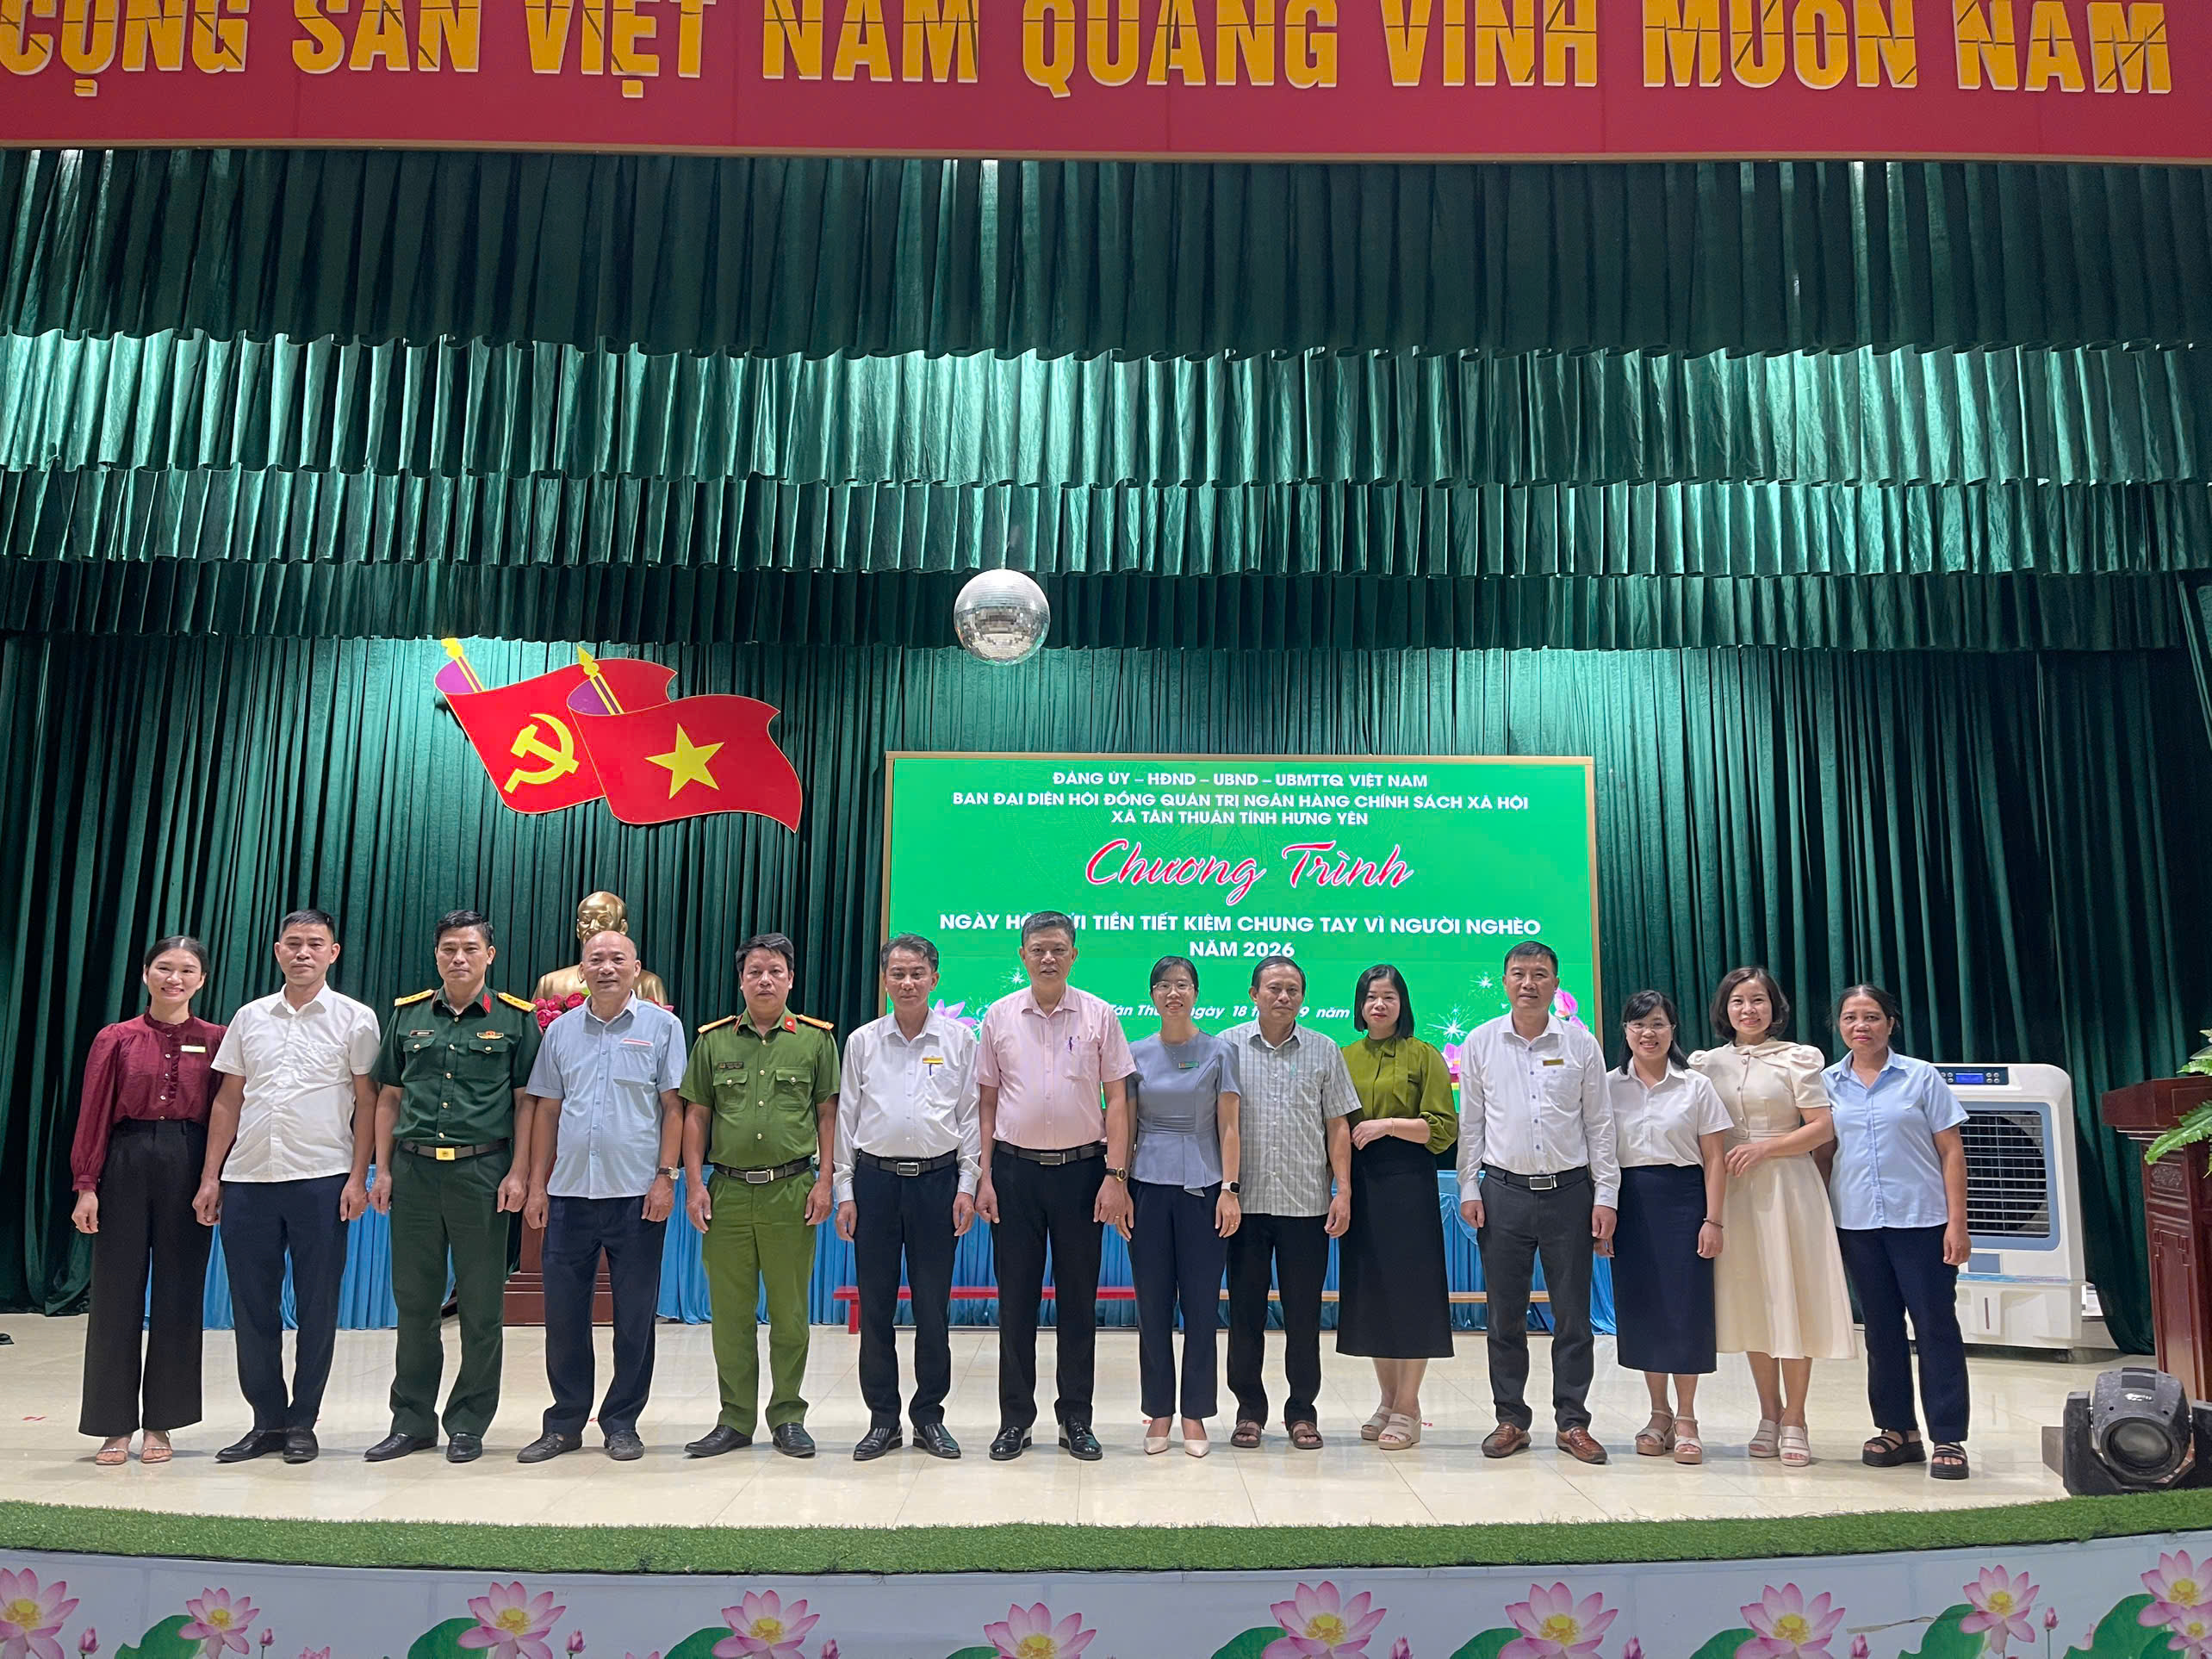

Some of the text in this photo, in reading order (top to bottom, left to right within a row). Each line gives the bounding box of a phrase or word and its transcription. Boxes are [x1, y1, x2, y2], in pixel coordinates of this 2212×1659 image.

[1148, 774, 1196, 786] HĐND
[1214, 774, 1258, 786] UBND
[1276, 774, 1344, 786] UBMTTQ
[1350, 774, 1382, 787] VIỆT
[1389, 775, 1426, 786] NAM
[954, 792, 988, 804] BAN
[993, 792, 1023, 805] ĐẠI
[1028, 792, 1064, 806] DIỆN
[1069, 792, 1098, 806] HỘI
[1160, 792, 1210, 806] QUẢN
[1215, 794, 1239, 808] TRỊ
[1244, 793, 1294, 806] NGÂN
[1299, 793, 1350, 807] HÀNG
[1354, 794, 1408, 808] CHÍNH
[1414, 795, 1462, 808] SÁCH
[1468, 796, 1492, 809] XÃ
[1498, 795, 1528, 810] HỘI
[1112, 810, 1136, 823] XÃ
[1141, 810, 1173, 823] TÂN
[1178, 810, 1234, 824] THUẬN
[1282, 813, 1331, 824] HƯNG
[1337, 811, 1368, 824] YÊN
[1085, 838, 1414, 906] Chương Trình
[941, 913, 999, 929] NGÀY
[1093, 912, 1134, 930] TIỀN
[1140, 913, 1177, 930] TIẾT
[1184, 914, 1231, 932] KIỆM
[1238, 916, 1314, 931] CHUNG
[1320, 917, 1358, 932] TAY
[1364, 916, 1383, 932] VÌ
[1391, 916, 1460, 934] NGƯỜI
[1467, 917, 1540, 935] NGHÈO
[1190, 940, 1296, 958] NĂM 2026
[1233, 1006, 1247, 1016] 18
[1300, 1007, 1309, 1016] 9
[1316, 1008, 1350, 1017] năm
